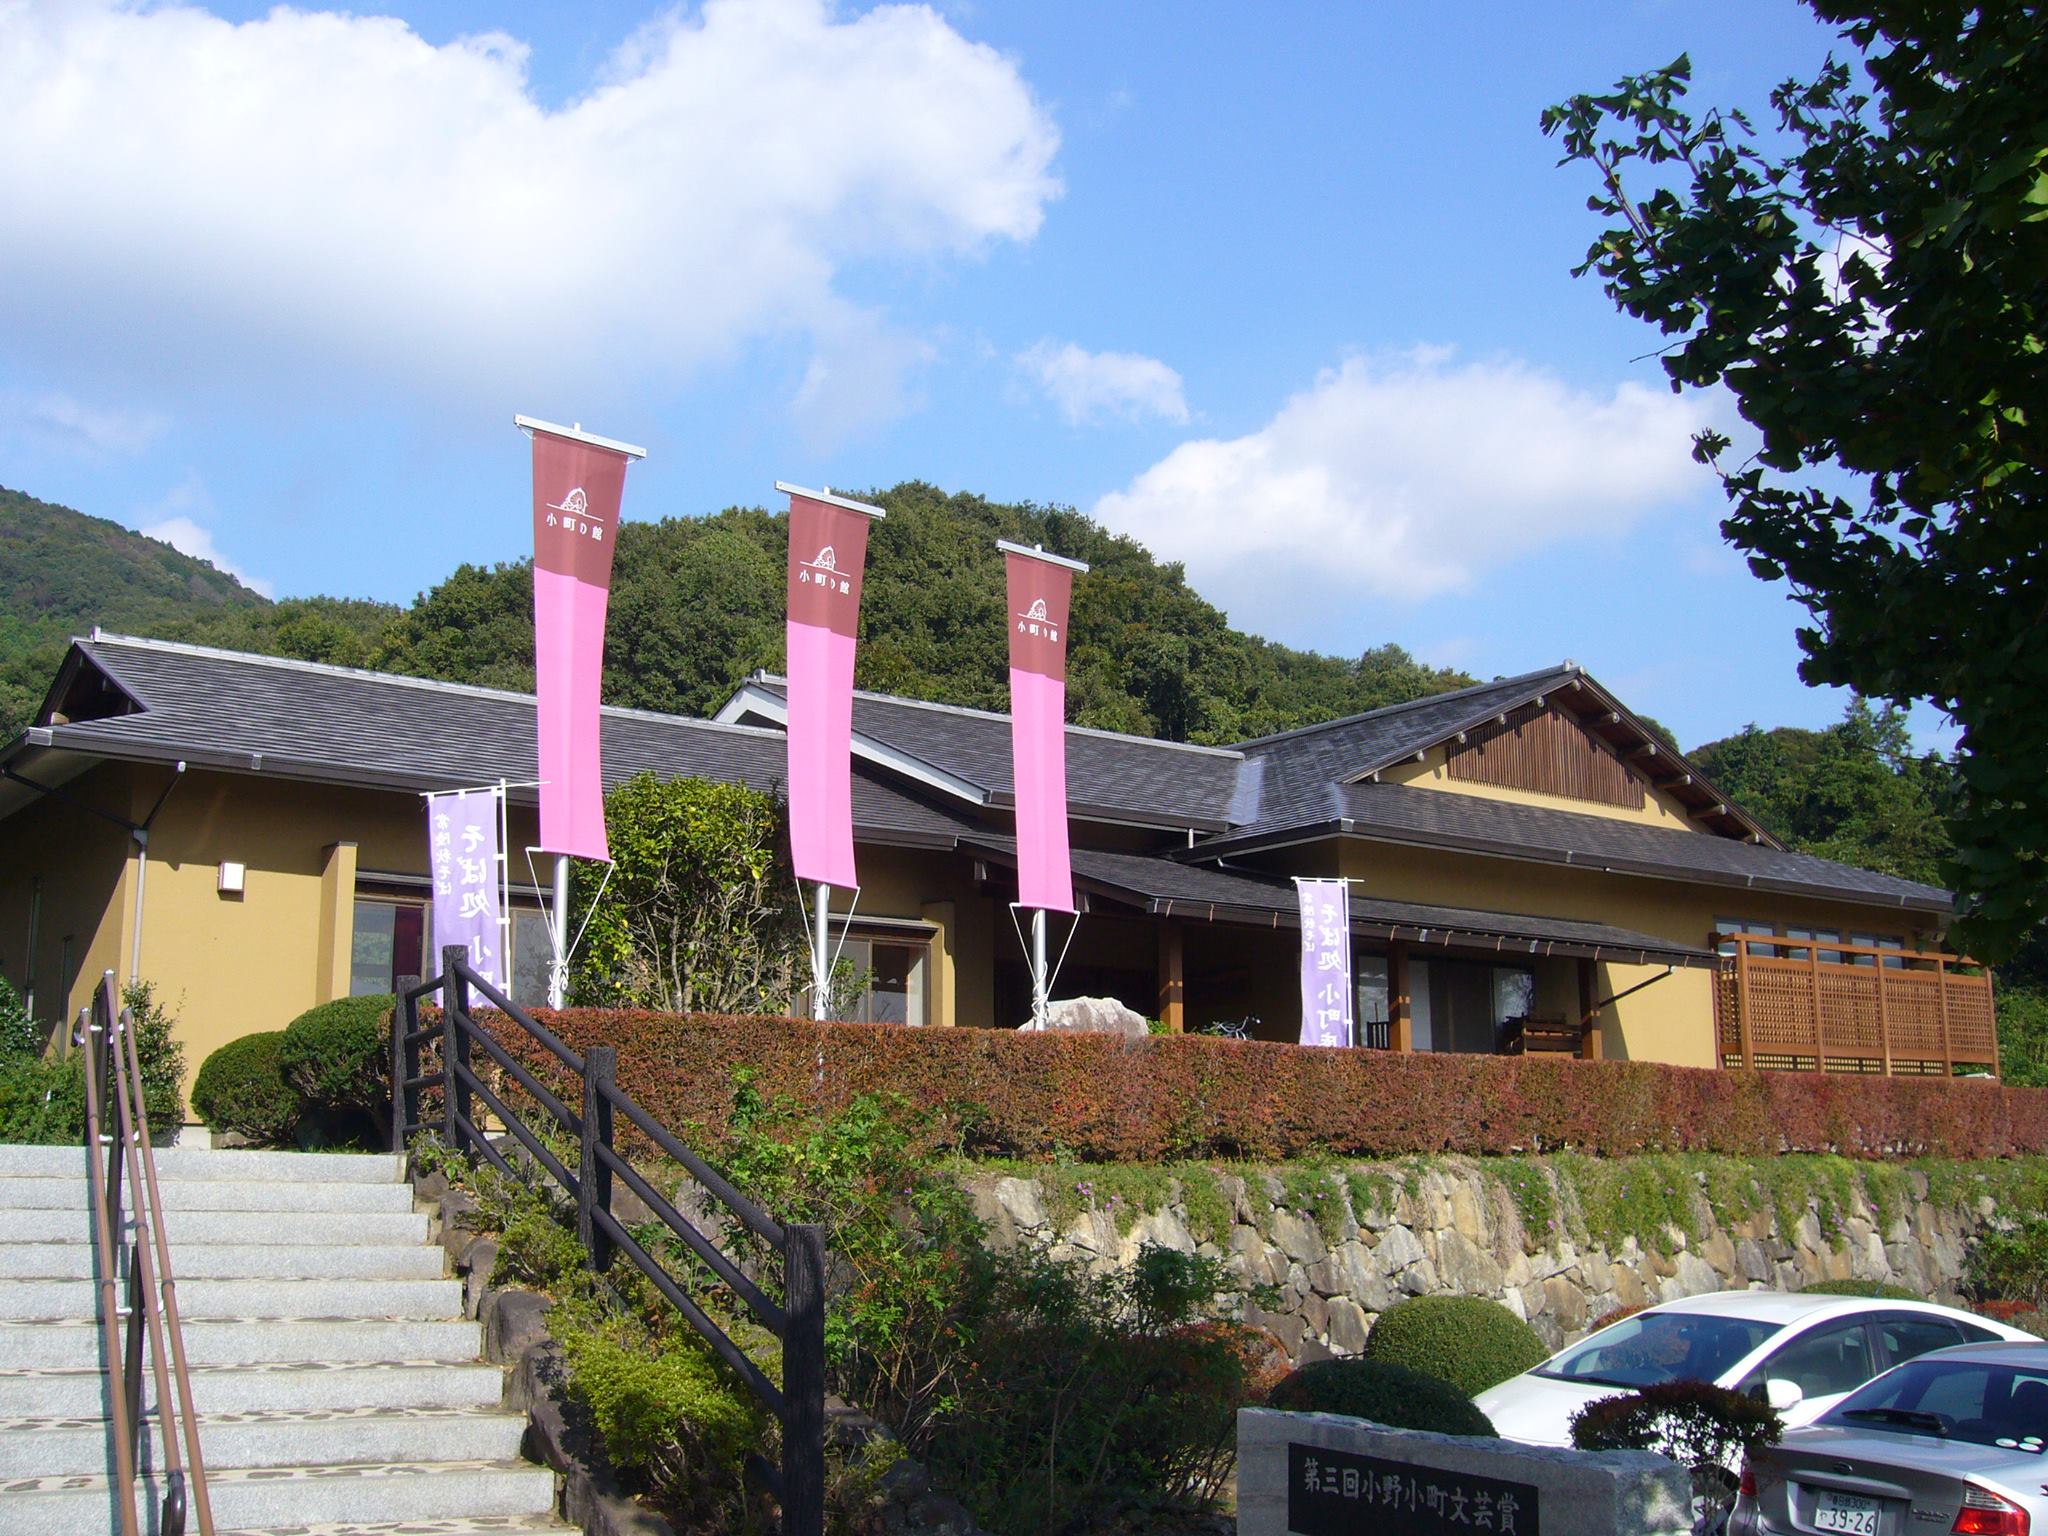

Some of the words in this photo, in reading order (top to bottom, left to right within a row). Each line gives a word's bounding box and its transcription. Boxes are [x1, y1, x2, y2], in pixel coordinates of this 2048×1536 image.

[1304, 1457, 1520, 1536] 第三回小野小町文芸賞
[1828, 1508, 1875, 1533] 39-26
